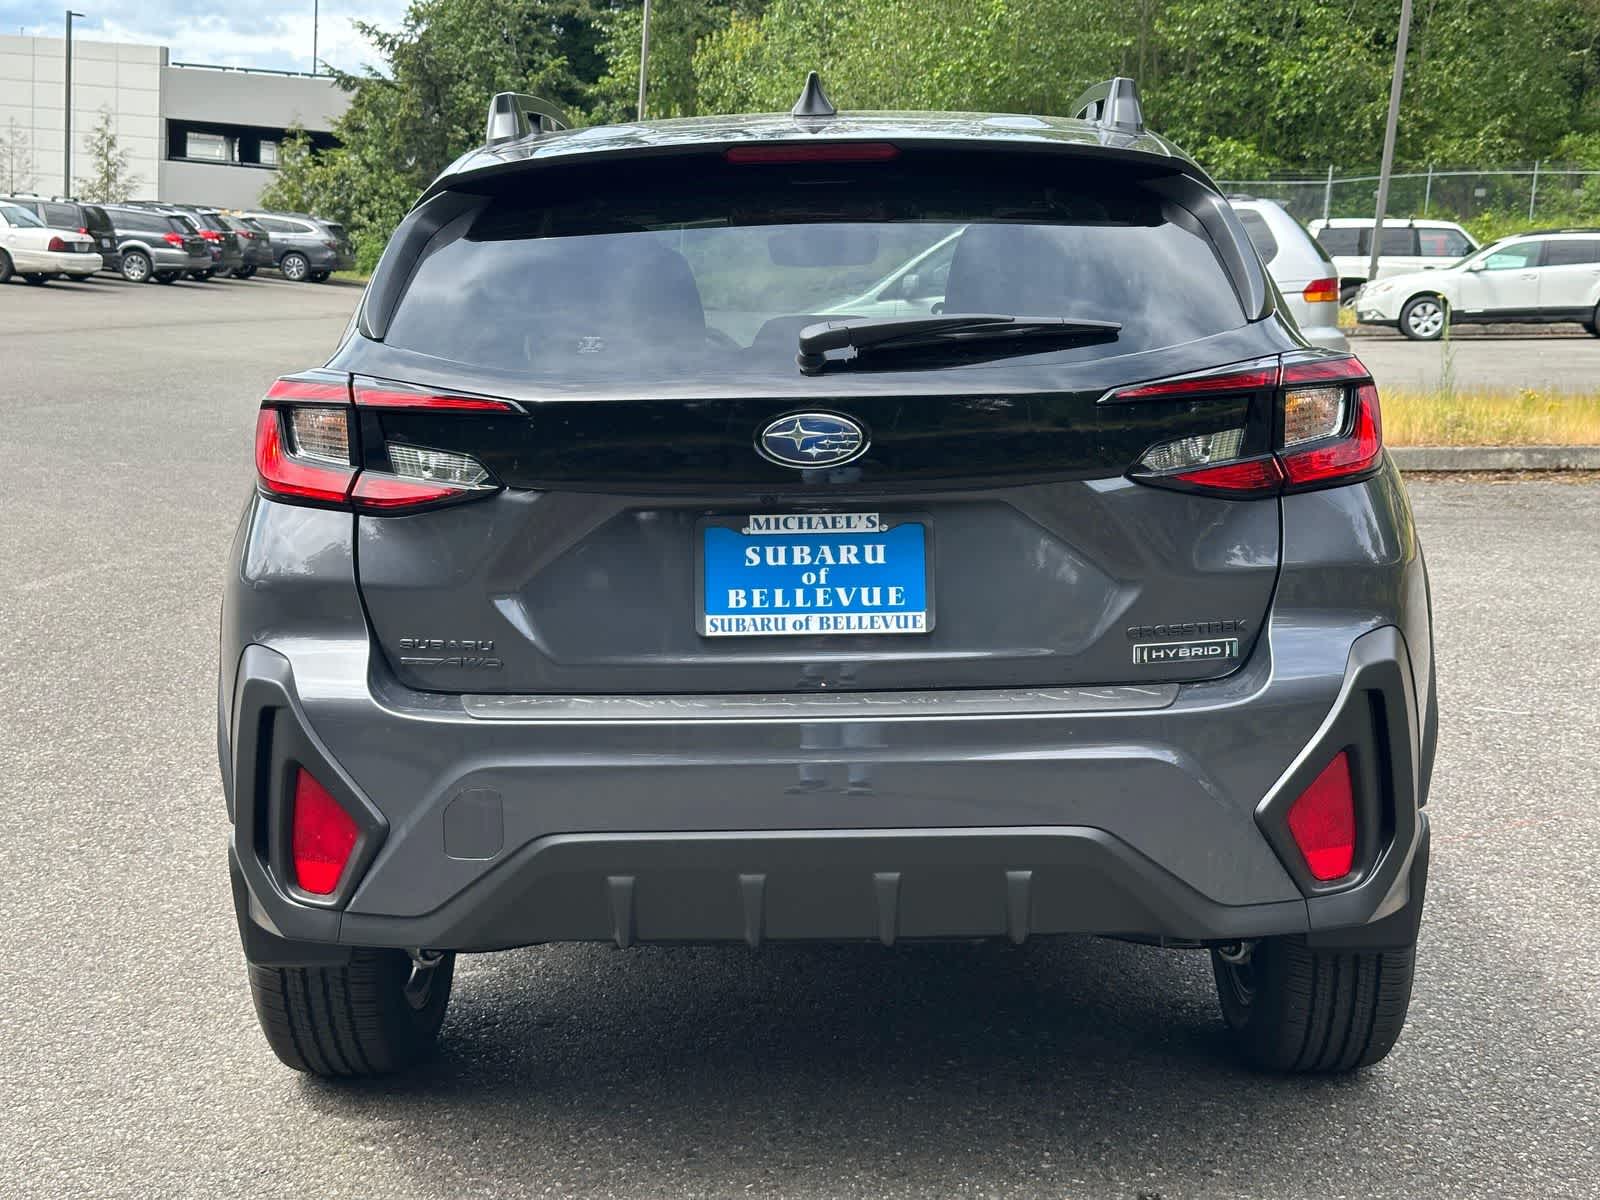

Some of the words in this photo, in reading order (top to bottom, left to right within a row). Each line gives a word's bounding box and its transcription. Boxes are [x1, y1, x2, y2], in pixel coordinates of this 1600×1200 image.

[752, 515, 877, 530] MICHAEL'S
[745, 545, 886, 566] SUBARU
[801, 568, 829, 585] of
[728, 587, 905, 608] BELLEVUE
[709, 617, 786, 633] SUBARU
[792, 616, 812, 631] of
[819, 615, 923, 631] BELLEVUE
[1127, 619, 1247, 637] CROSSTREK
[400, 638, 494, 650] SUBARU
[1152, 645, 1221, 658] HYBRID
